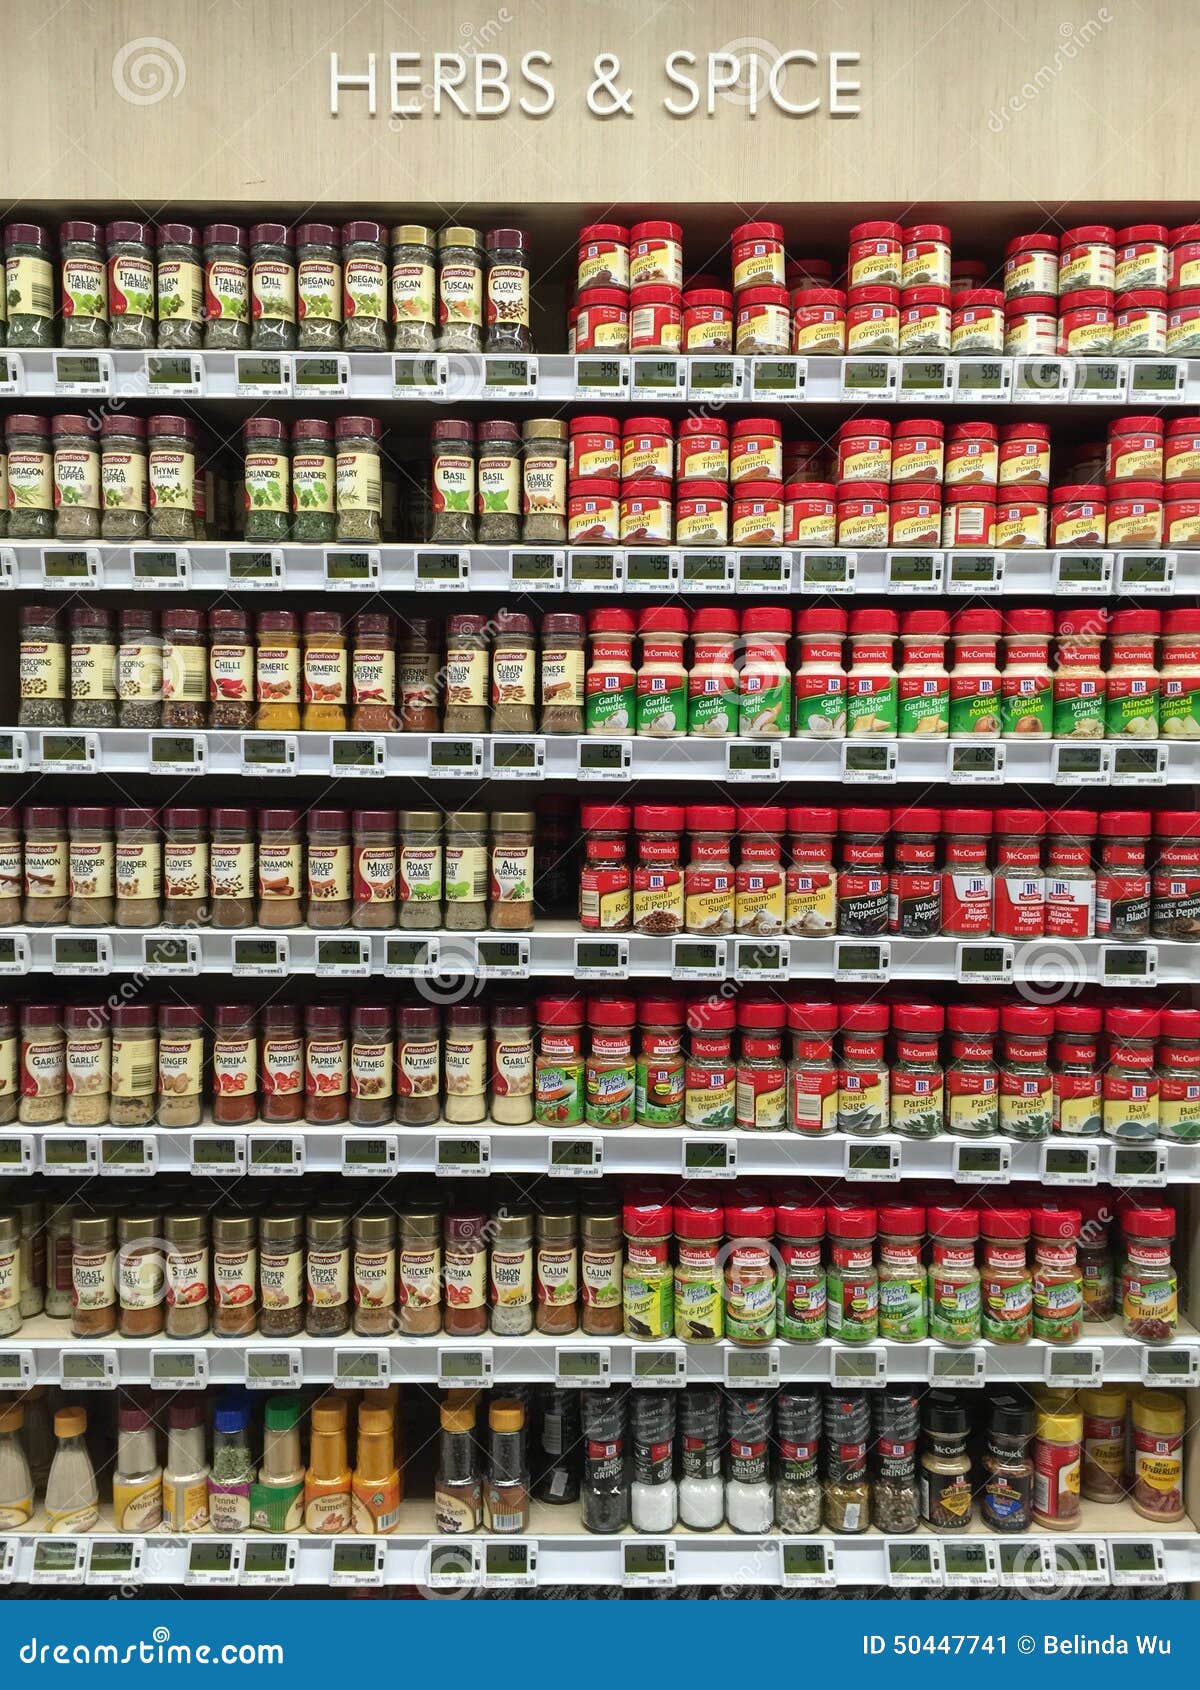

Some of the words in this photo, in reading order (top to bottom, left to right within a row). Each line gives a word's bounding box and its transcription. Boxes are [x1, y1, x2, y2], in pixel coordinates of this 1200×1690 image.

[331, 50, 556, 118] HERBS
[586, 53, 634, 117] &
[663, 50, 862, 118] SPICE
[256, 265, 287, 275] MasterFoods
[747, 264, 774, 275] Cumin
[863, 263, 897, 274] Oregano
[68, 273, 101, 285] ITALIAN
[119, 271, 152, 282] ITALIAN
[215, 276, 246, 288] ITALIAN
[261, 276, 281, 286] DILL
[348, 275, 383, 287] OREGANO
[71, 280, 97, 291] HERBS
[124, 280, 149, 291] HERBS
[219, 284, 243, 295] HERBS
[393, 280, 421, 288] TUSCAN
[444, 281, 473, 290] TUSCAN
[493, 280, 522, 290] CLOVES
[858, 326, 894, 339] Oregano
[633, 452, 660, 463] Smoked
[963, 458, 982, 467] Curry
[1021, 457, 1040, 467] Curry
[59, 465, 83, 475] PIZZA
[439, 460, 470, 469] MasterFoods
[899, 459, 939, 472] Cinnamon
[959, 464, 984, 474] Powder
[1016, 464, 1042, 474] Powder
[153, 466, 179, 476] THYME
[443, 470, 465, 481] BASIL
[483, 472, 504, 481] BASIL
[59, 473, 84, 481] TOPPER
[526, 473, 553, 483] GARLIC
[528, 481, 552, 489] PEPPER
[687, 522, 713, 533] Thyme
[741, 521, 775, 534] Turmeric
[1005, 521, 1024, 532] Curry
[1076, 519, 1092, 528] Chili
[1071, 525, 1098, 536] Powder
[1008, 650, 1046, 659] McCormick
[1114, 652, 1153, 660] McCormick
[215, 660, 240, 670] CHILLI
[306, 663, 341, 672] TURMERIC
[497, 663, 523, 673] CUMIN
[355, 672, 379, 680] PEPPER
[598, 693, 623, 705] Garlic
[646, 695, 670, 706] Garlic
[699, 697, 723, 708] Garlic
[743, 694, 765, 706] Garlic
[867, 693, 891, 704] Bread
[1014, 696, 1041, 708] Onion
[1123, 698, 1154, 710] Minced
[595, 701, 627, 715] Powder
[643, 703, 674, 716] Powder
[746, 703, 761, 715] Salt
[825, 705, 841, 715] Salt
[904, 699, 929, 712] Garlic
[1071, 698, 1102, 711] Minced
[696, 704, 727, 717] Powder
[850, 705, 884, 718] Sprinkle
[912, 705, 946, 720] Sprinkle
[1011, 704, 1044, 717] Powder
[1074, 707, 1100, 718] Garlic
[1122, 706, 1153, 718] Onions
[404, 851, 435, 859] MasterFoods
[309, 861, 333, 870] MIXED
[368, 862, 393, 871] MIXED
[406, 862, 432, 871] ROAST
[502, 860, 518, 870] ALL
[371, 869, 390, 877] SPICE
[641, 891, 673, 903] CRUSHED
[650, 897, 681, 911] Pepper
[708, 901, 730, 914] Sugar
[744, 902, 768, 913] Sugar
[793, 901, 818, 913] Sugar
[849, 900, 875, 911] Whole
[915, 901, 938, 912] Whole
[965, 913, 989, 921] Pepper
[1047, 917, 1075, 925] Pepper
[594, 1038, 628, 1047] McCormick
[1010, 1048, 1047, 1057] McCormick
[70, 1054, 99, 1064] GARLIC
[216, 1055, 246, 1065] PAPRIKA
[268, 1054, 300, 1064] PAPRIKA
[310, 1055, 343, 1065] PAPRIKA
[353, 1057, 385, 1068] NUTMEG
[405, 1056, 438, 1066] NUTMEG
[502, 1056, 530, 1066] GARLIC
[842, 1100, 865, 1112] Sage
[903, 1097, 937, 1109] Parsley
[1011, 1097, 1047, 1110] Parsley
[1128, 1102, 1148, 1114] Bay
[1016, 1106, 1041, 1115] FLAKES
[75, 1269, 101, 1278] ROAST
[171, 1266, 198, 1276] STEAK
[218, 1267, 242, 1276] STEAK
[311, 1266, 338, 1276] PEPPER
[356, 1266, 386, 1277] CHICKEN
[402, 1265, 435, 1274] CHICKEN
[494, 1265, 521, 1276] LEMON
[542, 1265, 568, 1274] CAJUN
[585, 1264, 612, 1277] CAJUN
[312, 1274, 335, 1282] STEAK
[495, 1274, 520, 1282] PEPPER
[1138, 1305, 1169, 1317] Italian
[732, 1463, 766, 1474] GRINDER
[214, 1496, 239, 1505] Fennel
[129, 1501, 150, 1512] White
[216, 1504, 236, 1513] Seeds
